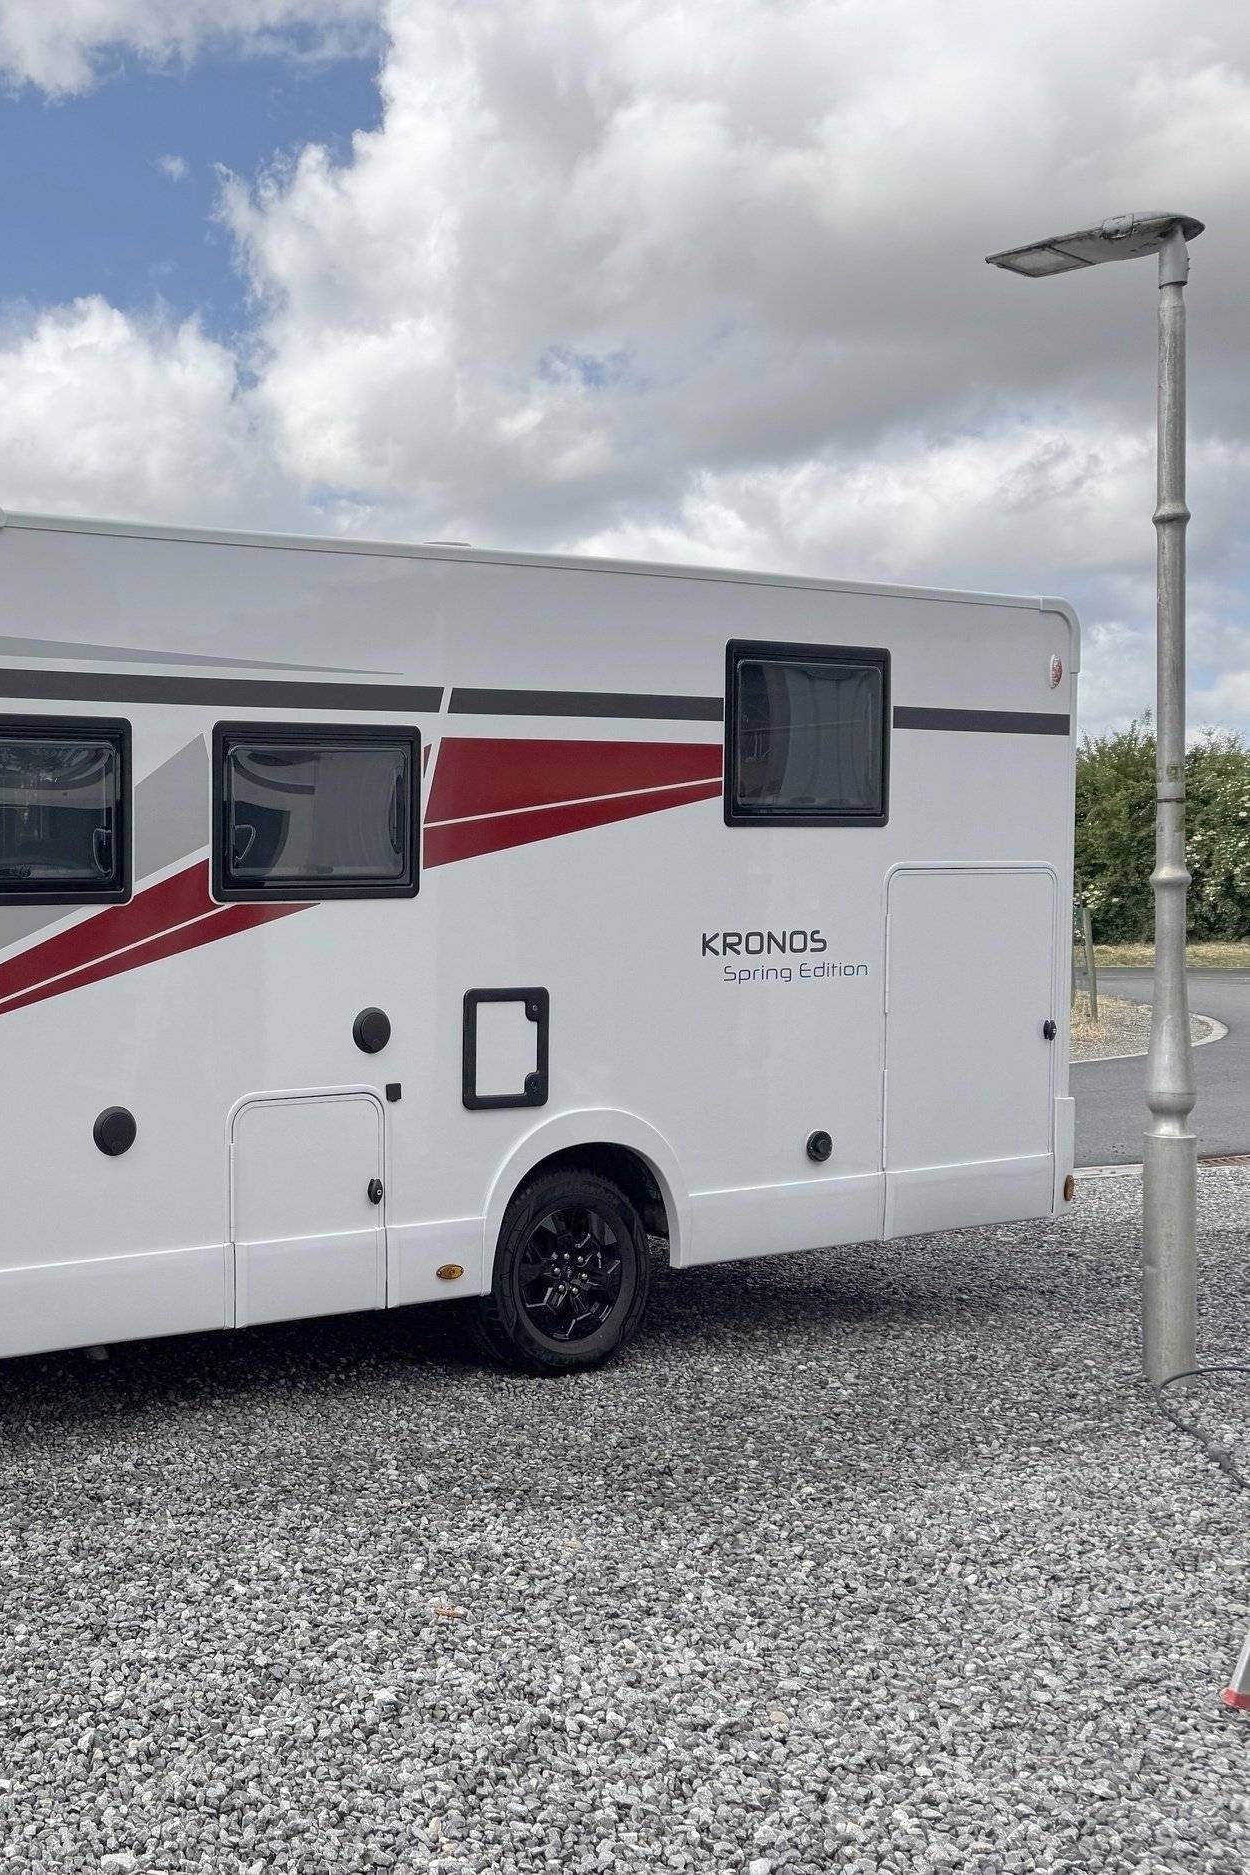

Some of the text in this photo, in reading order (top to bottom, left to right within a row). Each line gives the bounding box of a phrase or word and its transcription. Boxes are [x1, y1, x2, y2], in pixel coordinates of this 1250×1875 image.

[701, 929, 828, 957] KRONOS
[723, 961, 868, 985] Spring Edition
